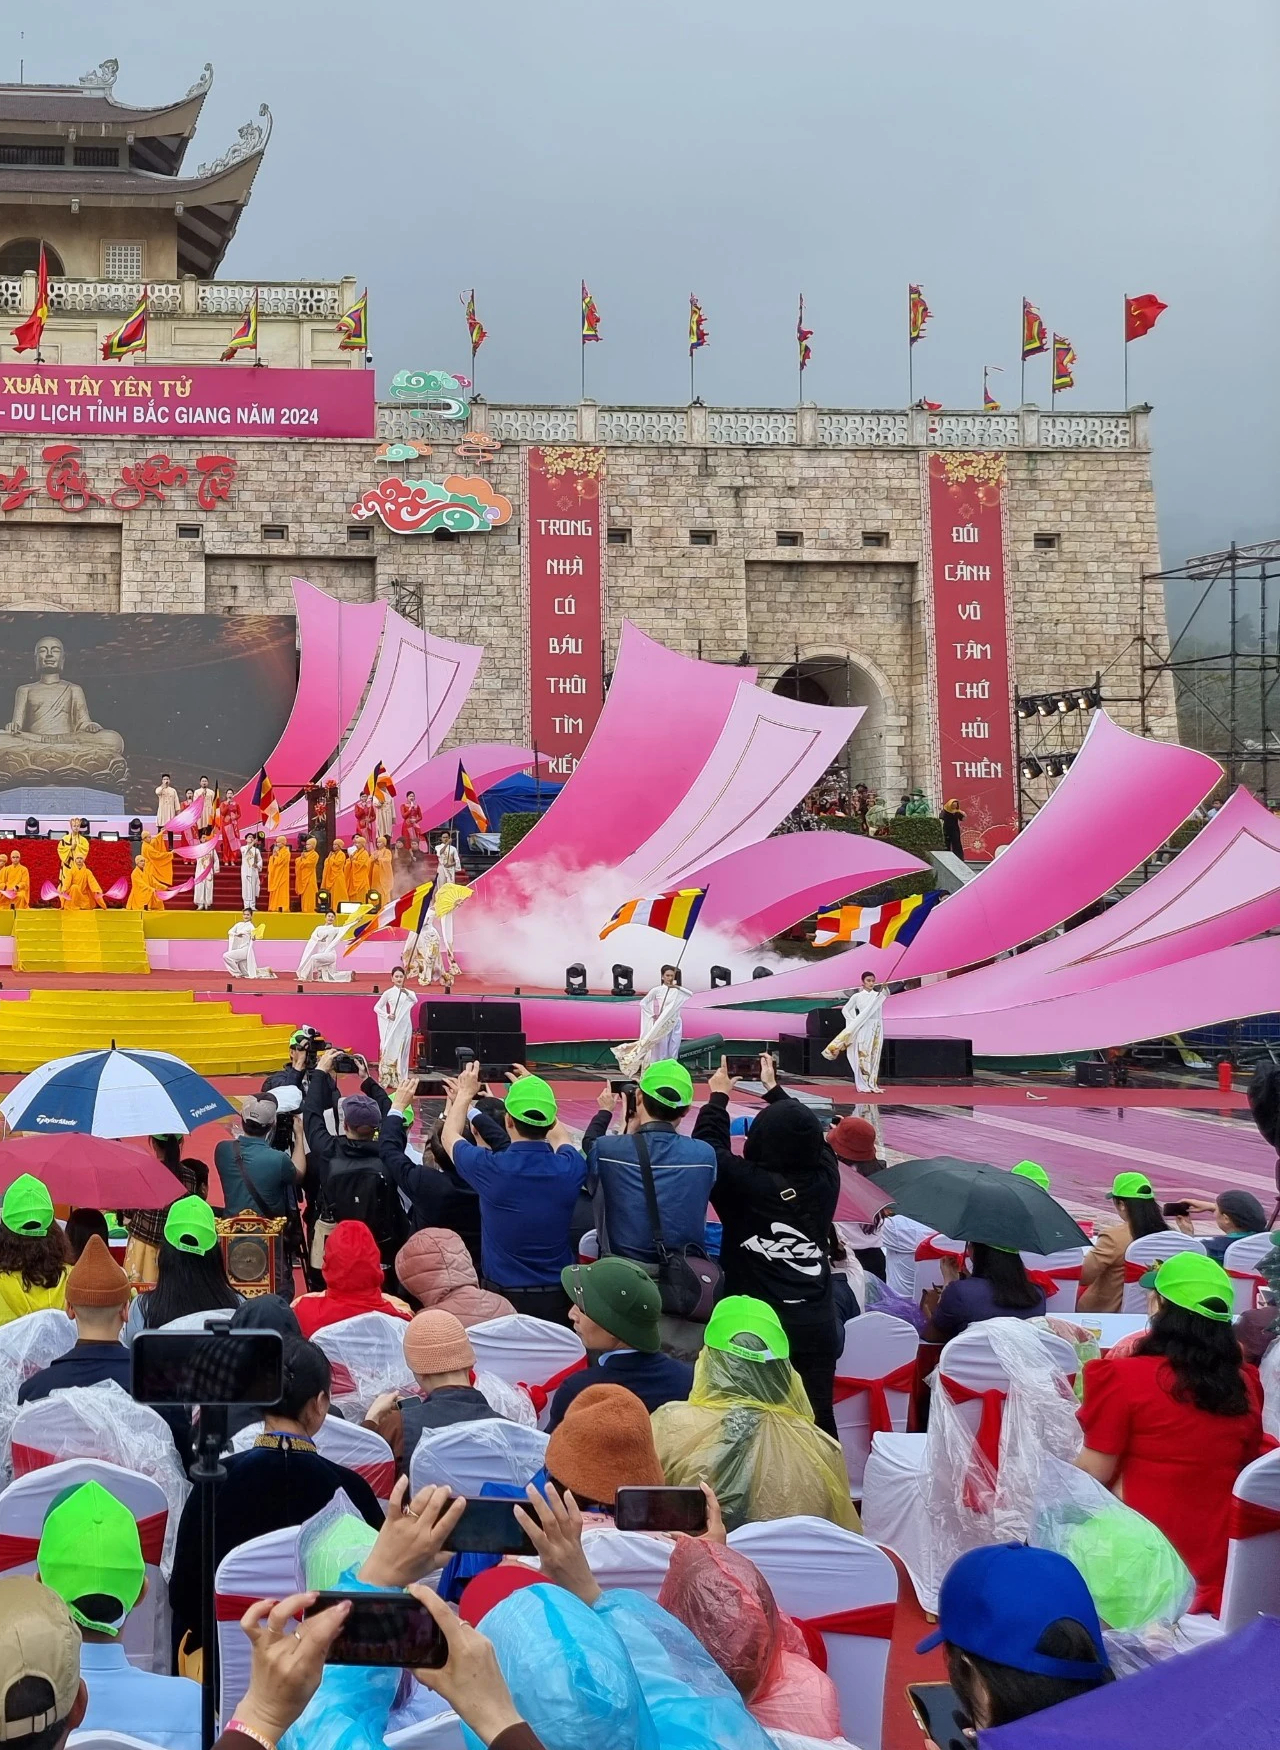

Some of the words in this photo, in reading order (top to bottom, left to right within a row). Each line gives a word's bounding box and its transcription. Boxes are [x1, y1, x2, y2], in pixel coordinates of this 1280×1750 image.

[3, 374, 58, 395] XUÂN
[65, 375, 103, 396] TÂY
[110, 376, 152, 398] YÊN
[159, 376, 192, 397] TỬ
[12, 404, 35, 420] DU
[42, 405, 80, 424] LỊCH
[87, 399, 126, 422] TỈNH
[134, 396, 169, 423] BẮC
[175, 407, 230, 423] GIANG
[237, 403, 274, 424] NĂM
[281, 408, 318, 424] 2024
[537, 520, 591, 535] TRONG
[951, 523, 978, 542] ĐỐI
[547, 556, 582, 575] NHÀ
[945, 561, 990, 581] CẢNH
[555, 595, 575, 614] CÓ
[958, 601, 980, 619] VÔ
[550, 634, 582, 654] BÁU
[953, 640, 990, 659] TÂM
[546, 675, 586, 693] THÔI
[956, 679, 989, 698] CHỚ
[552, 715, 582, 733] TÌM
[961, 717, 988, 738] HỎI
[952, 757, 1001, 777] THIỀN
